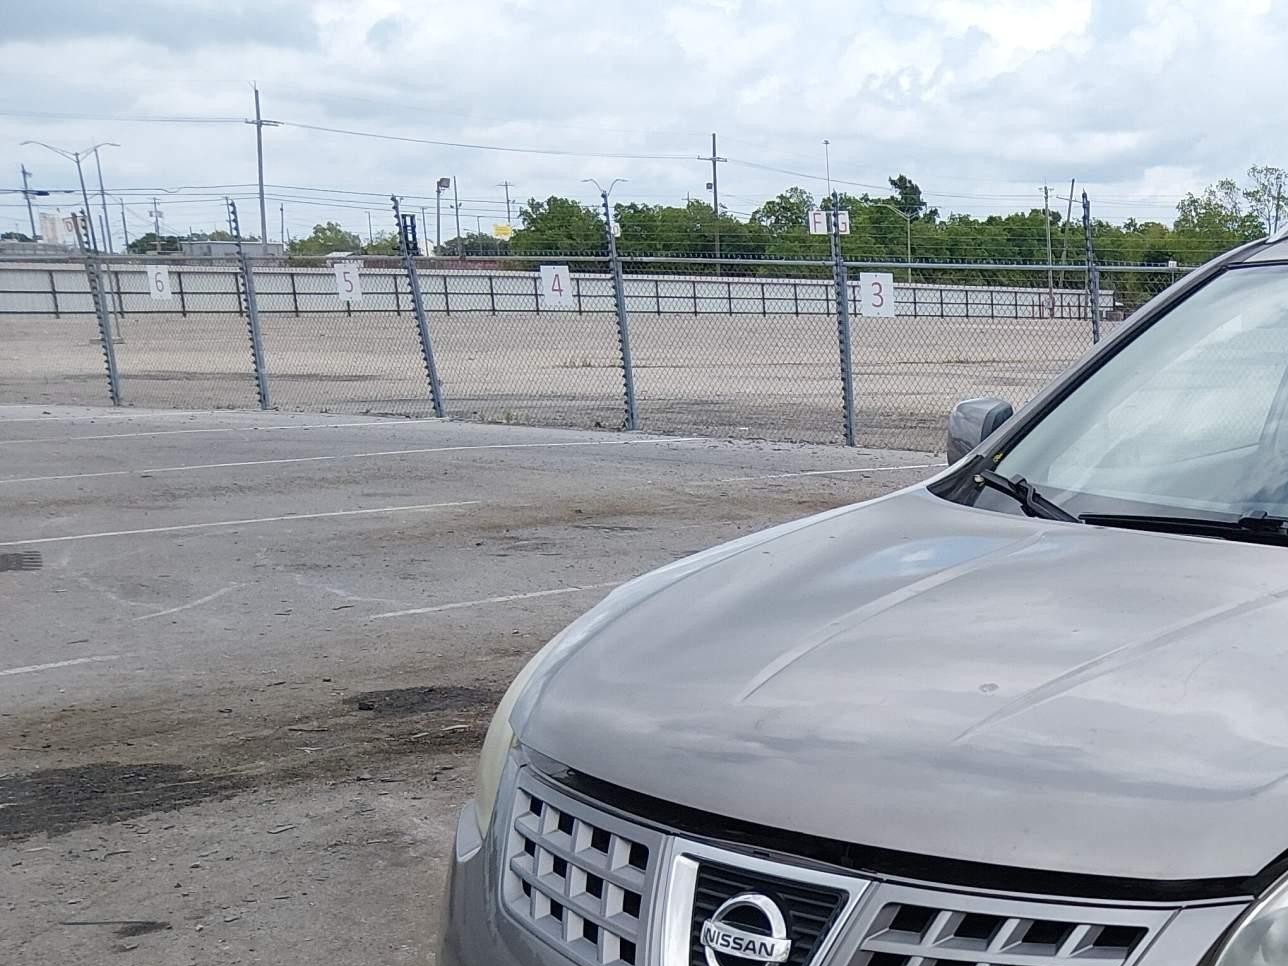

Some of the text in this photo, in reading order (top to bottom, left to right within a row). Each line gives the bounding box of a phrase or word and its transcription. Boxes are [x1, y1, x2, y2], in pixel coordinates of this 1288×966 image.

[812, 212, 822, 233] F
[838, 212, 848, 233] G
[154, 271, 165, 293] 6
[343, 271, 354, 293] 5
[551, 273, 563, 297] 4
[871, 281, 884, 308] 3
[705, 927, 775, 956] NISSAN
